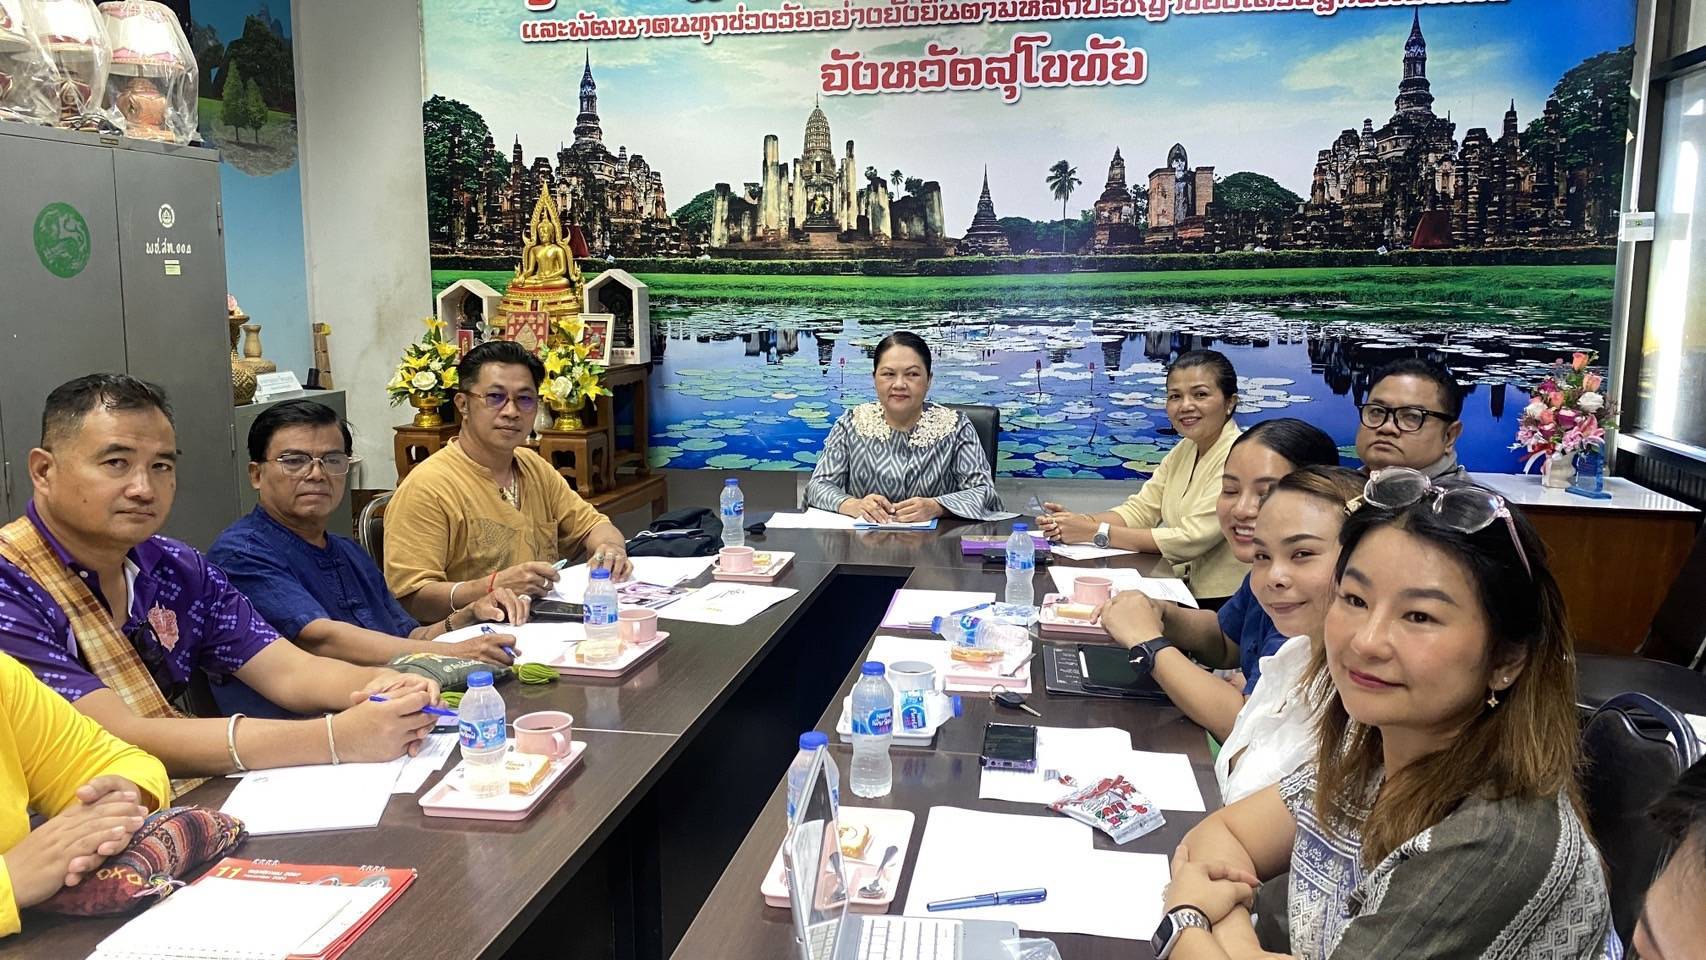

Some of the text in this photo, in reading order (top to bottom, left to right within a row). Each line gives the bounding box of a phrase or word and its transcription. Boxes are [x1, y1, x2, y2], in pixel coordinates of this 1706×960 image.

[820, 34, 1144, 100] จังหวัดสุโขทัย
[215, 866, 243, 879] 11
